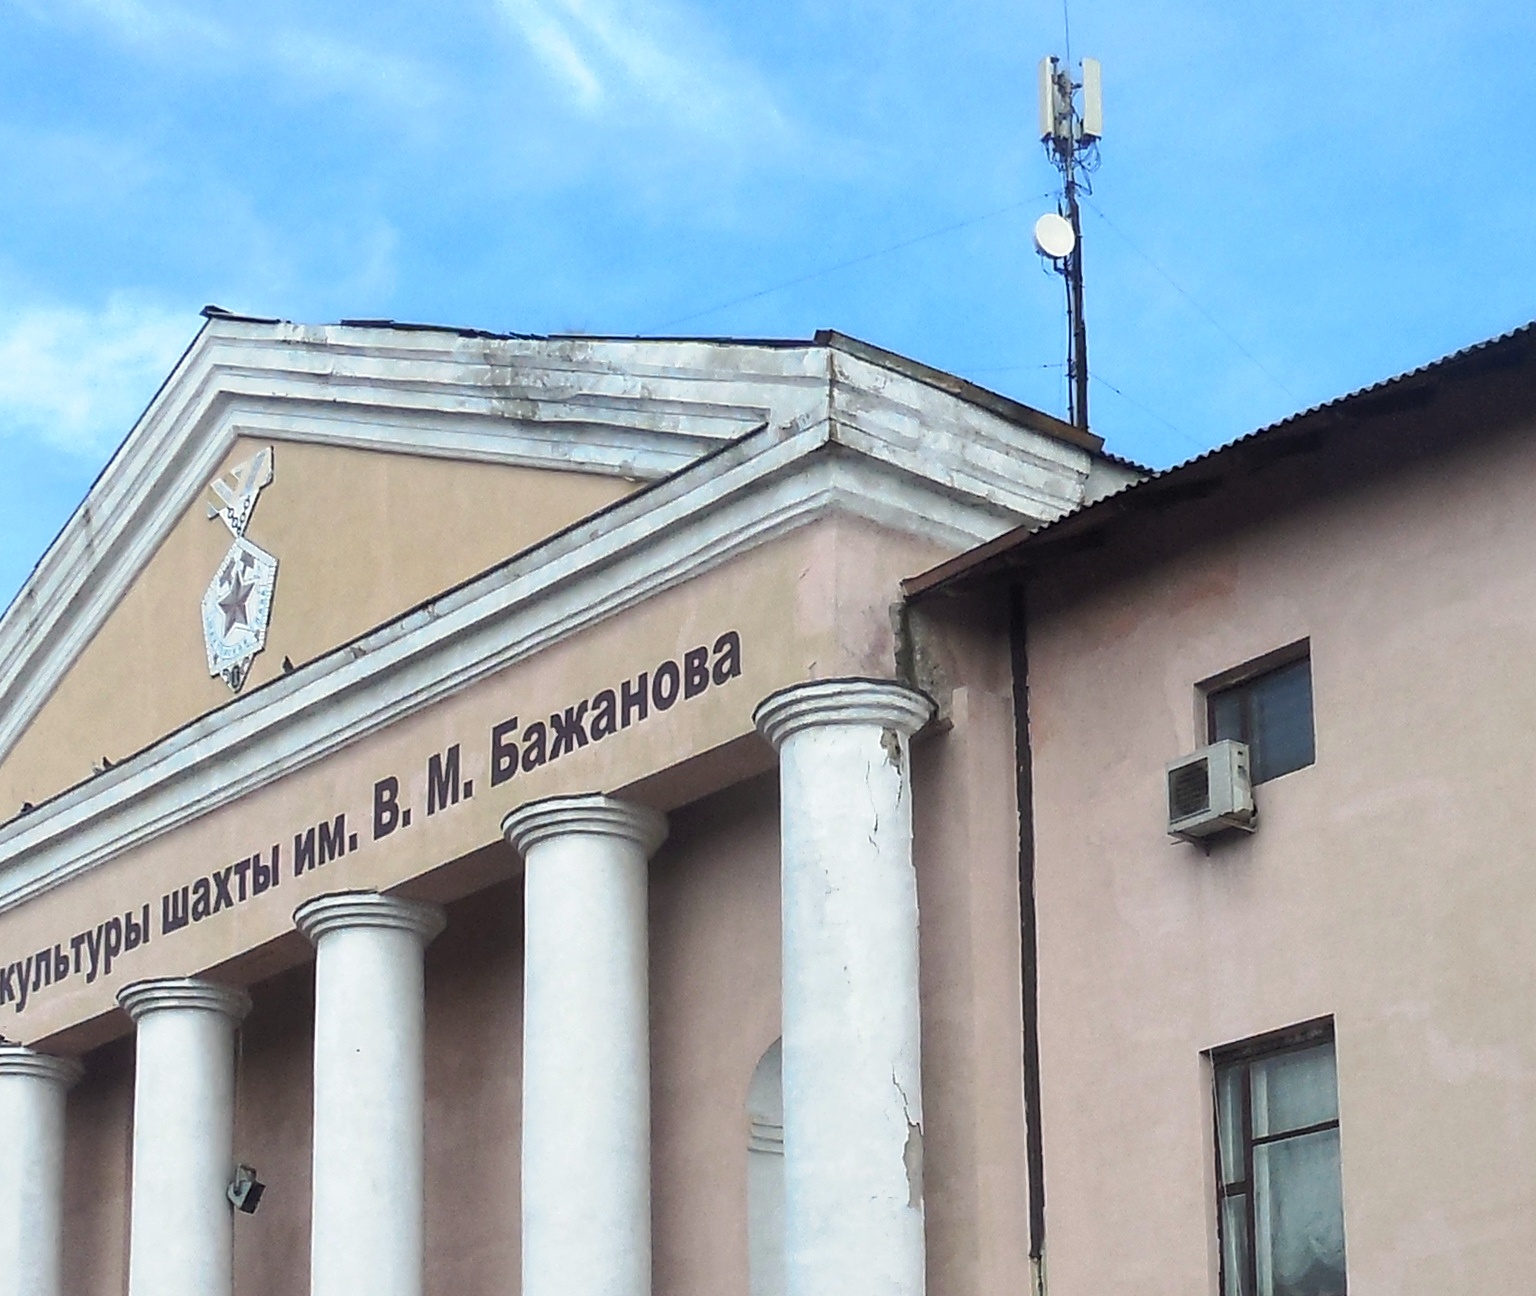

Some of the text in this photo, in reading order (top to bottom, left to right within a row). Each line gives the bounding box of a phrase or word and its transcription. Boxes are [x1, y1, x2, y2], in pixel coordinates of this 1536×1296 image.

[0, 903, 151, 1013] культуры
[162, 843, 280, 935] шахты
[294, 813, 359, 877] им.
[373, 776, 412, 841] В.
[427, 743, 473, 817] М.
[490, 630, 742, 788] Бажанова
